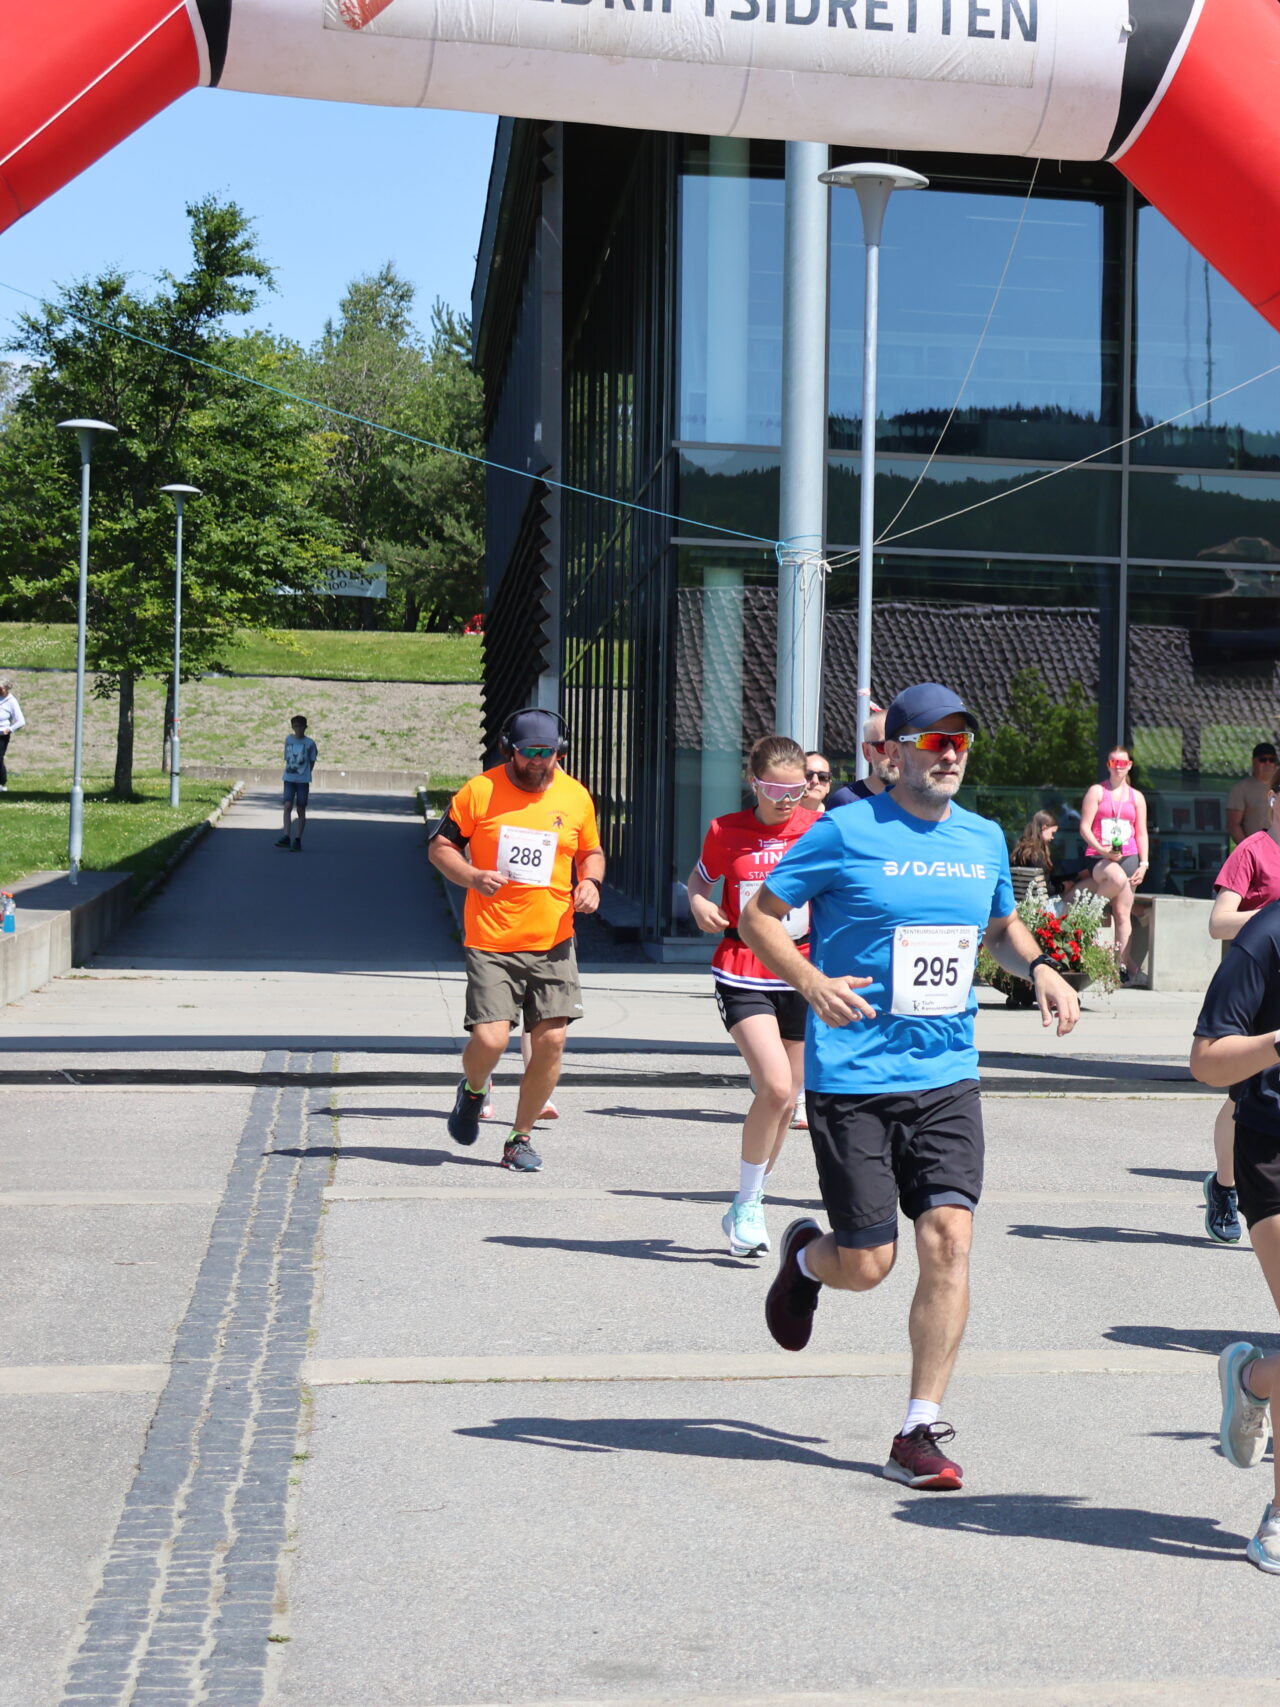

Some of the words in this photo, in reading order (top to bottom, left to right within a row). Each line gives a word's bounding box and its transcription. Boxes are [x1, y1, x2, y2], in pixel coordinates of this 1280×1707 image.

[509, 846, 542, 867] 288
[751, 851, 787, 865] TIN
[913, 956, 959, 986] 295
